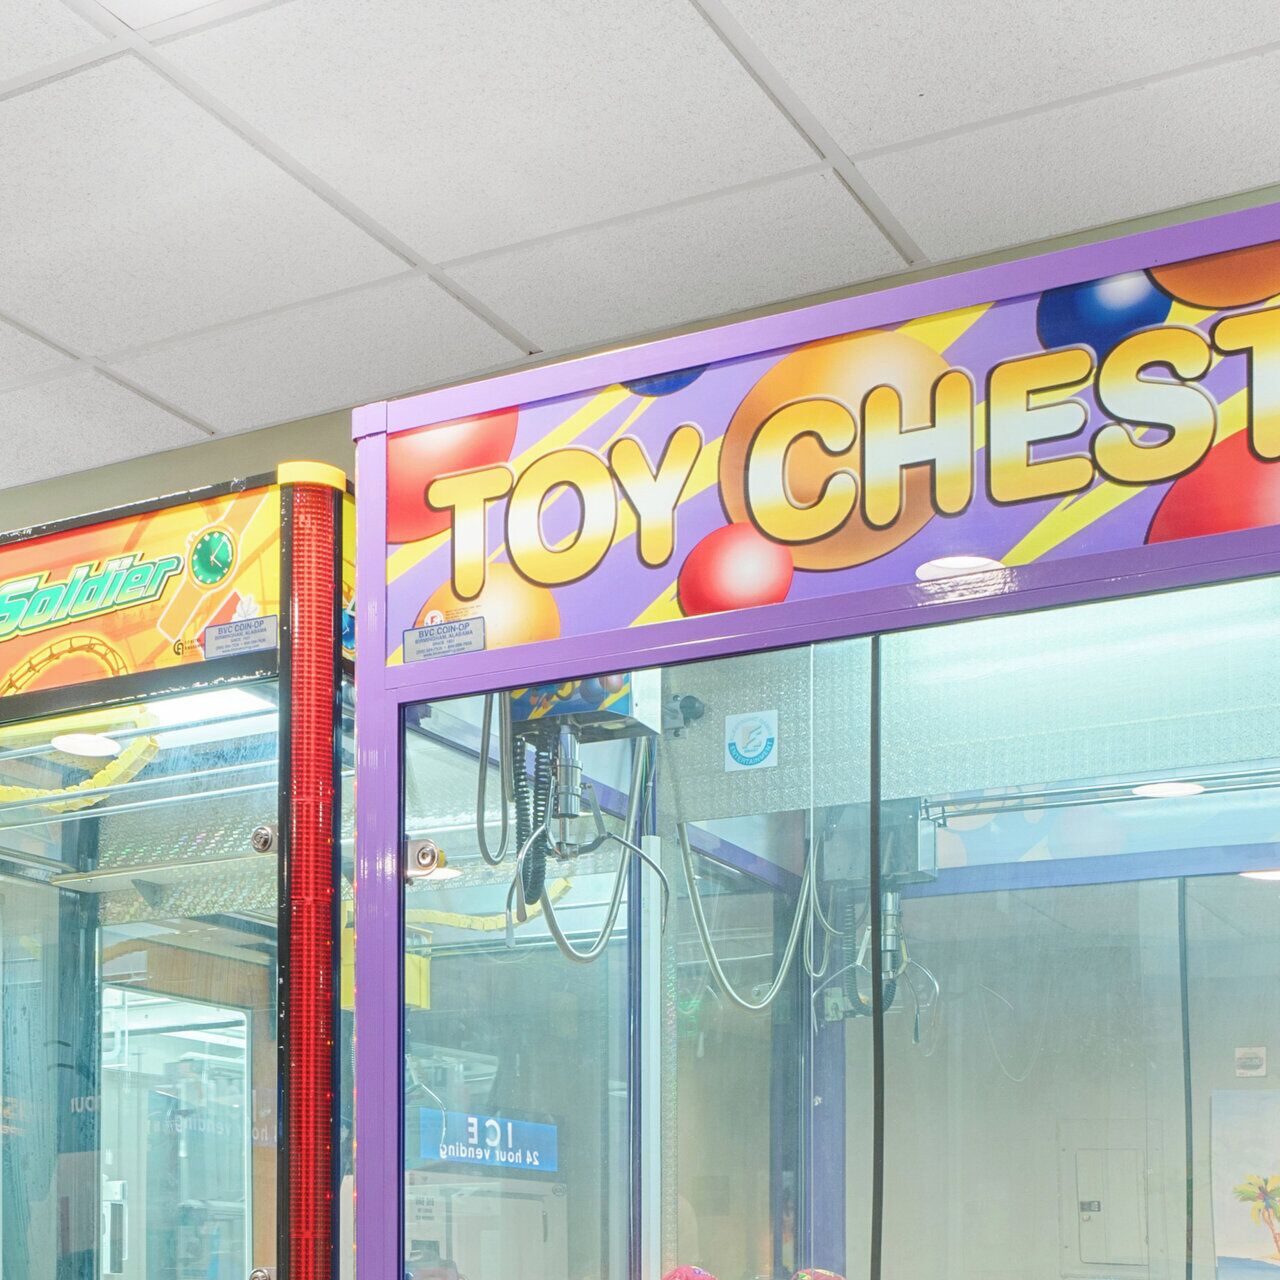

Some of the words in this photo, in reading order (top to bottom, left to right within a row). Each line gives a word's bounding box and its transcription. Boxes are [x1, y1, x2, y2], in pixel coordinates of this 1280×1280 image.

[423, 420, 705, 601] TOY
[235, 620, 264, 632] COIN-OP
[419, 629, 435, 638] BVC
[437, 622, 470, 635] COIN-OP
